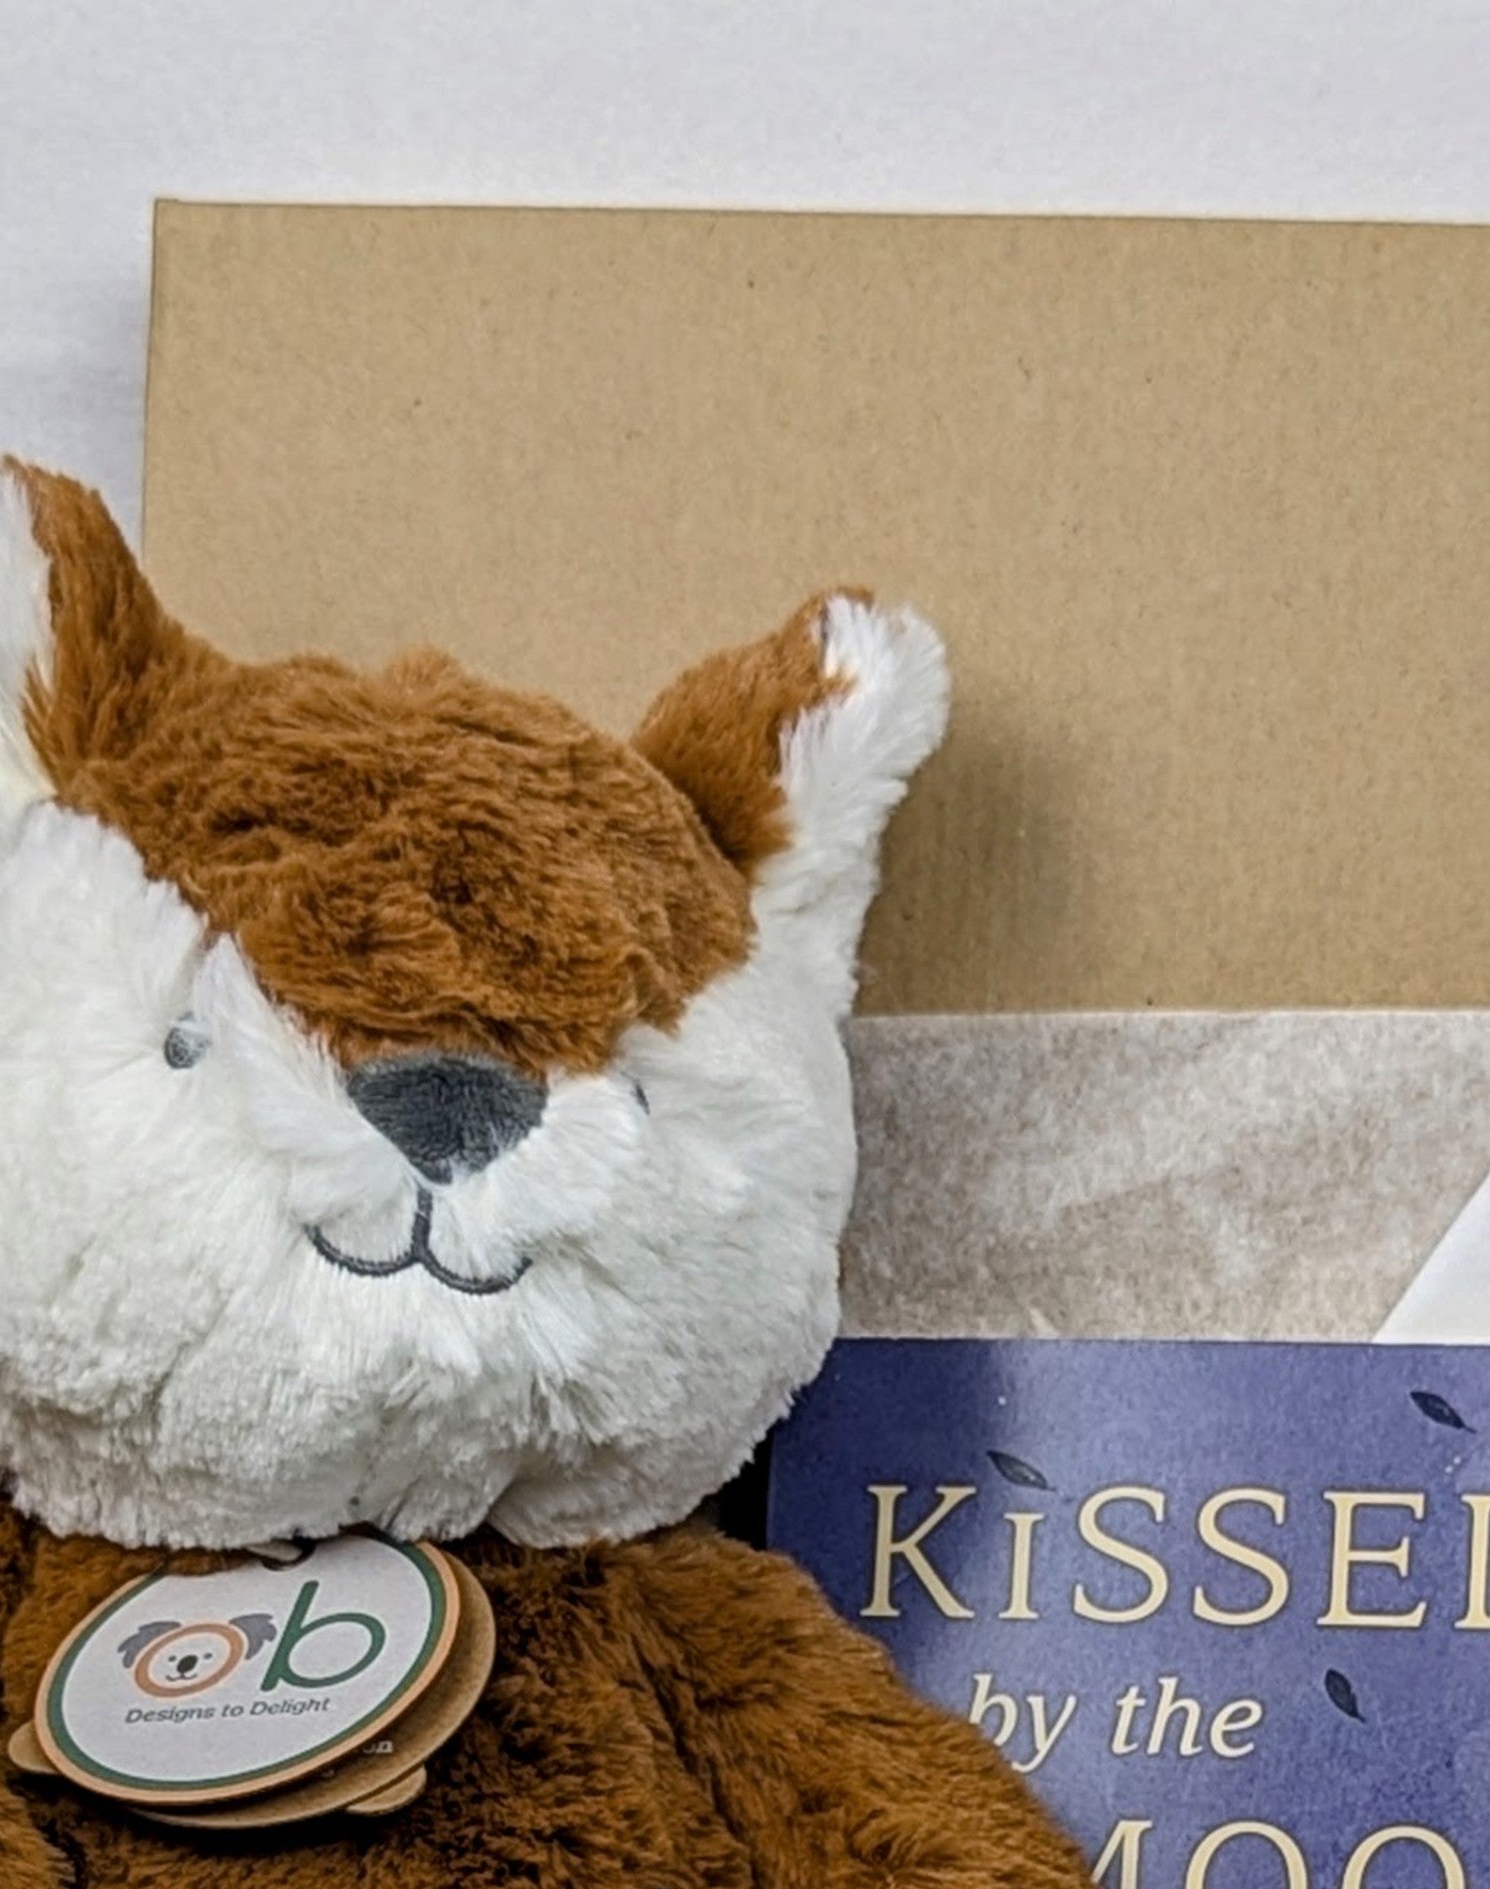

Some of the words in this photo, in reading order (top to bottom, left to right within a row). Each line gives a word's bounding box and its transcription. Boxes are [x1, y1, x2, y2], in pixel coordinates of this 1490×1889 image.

[124, 1706, 215, 1724] Designs
[221, 1703, 244, 1718] to
[250, 1698, 332, 1716] Delight
[969, 1674, 1077, 1771] by
[1111, 1669, 1262, 1757] the
